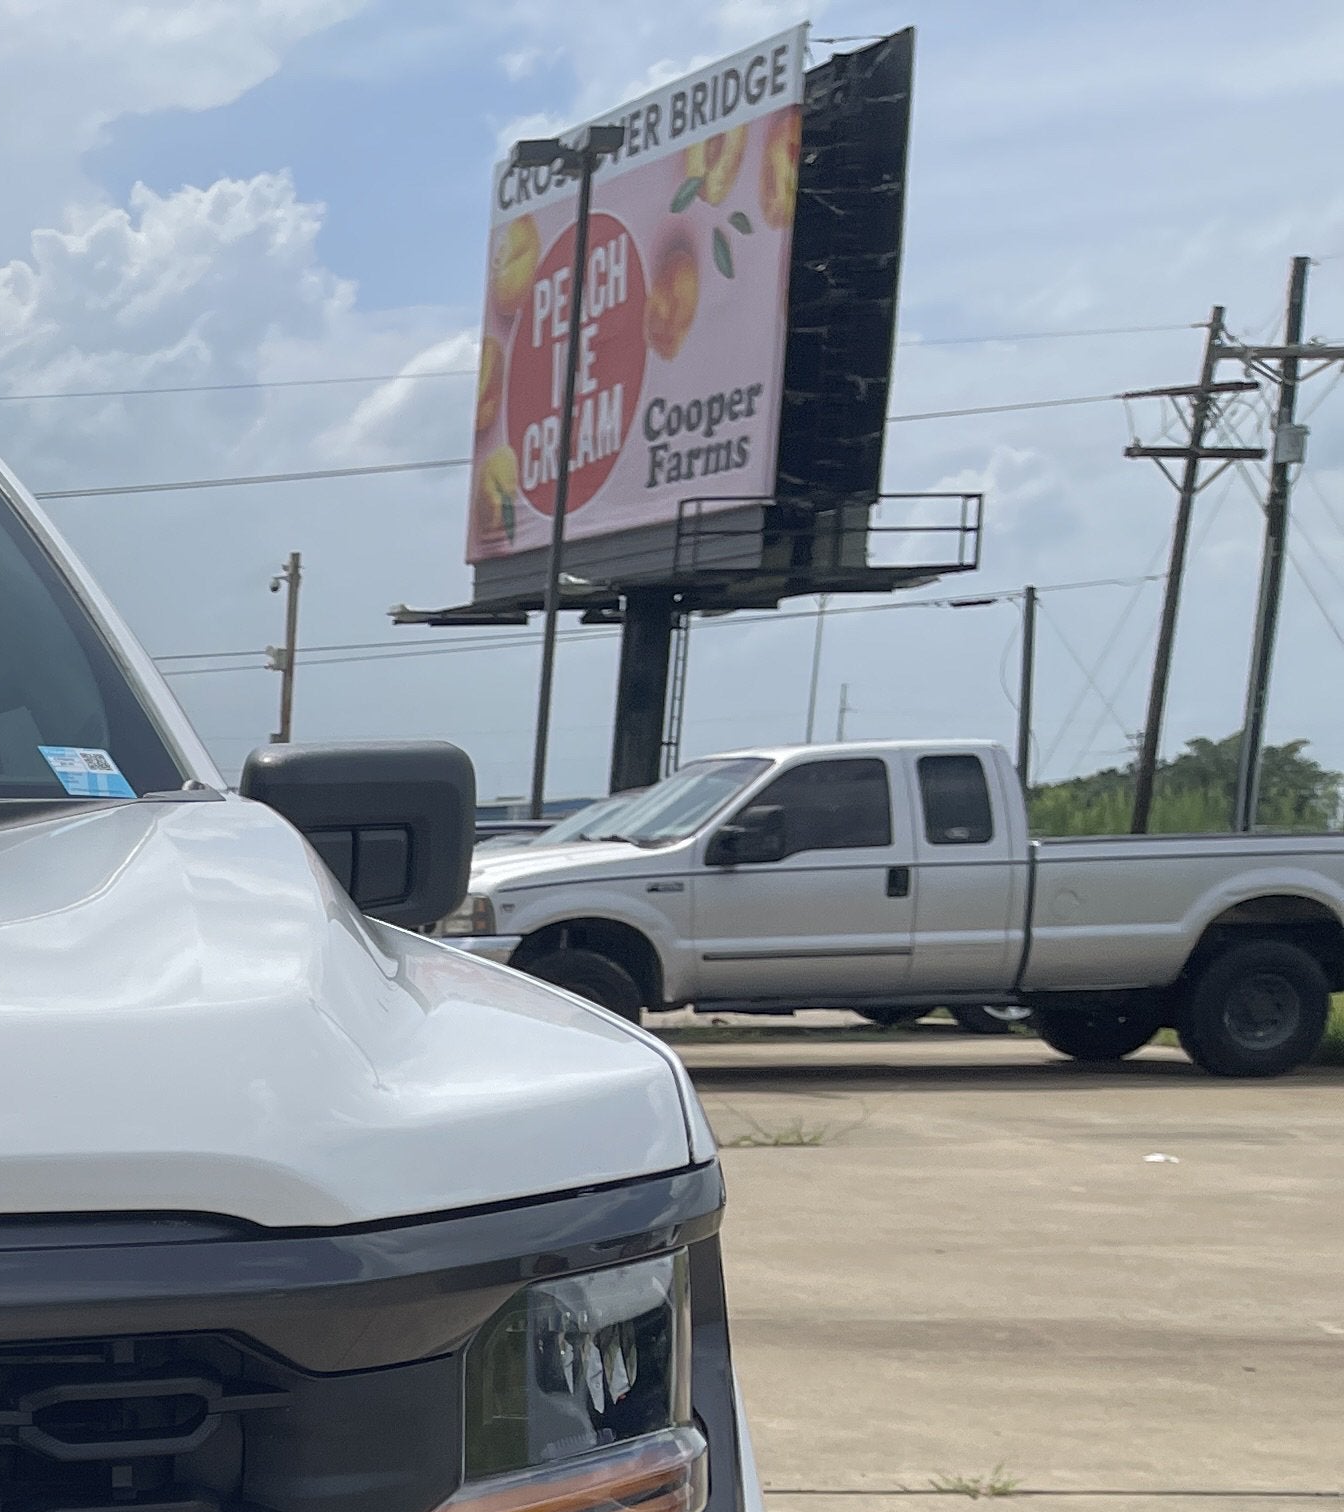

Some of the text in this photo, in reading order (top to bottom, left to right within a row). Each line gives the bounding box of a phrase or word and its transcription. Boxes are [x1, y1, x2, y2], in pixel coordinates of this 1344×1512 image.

[669, 44, 788, 138] BRIDGE
[551, 322, 599, 409] IE
[644, 383, 763, 442] Cooper
[644, 435, 750, 489] Farms
